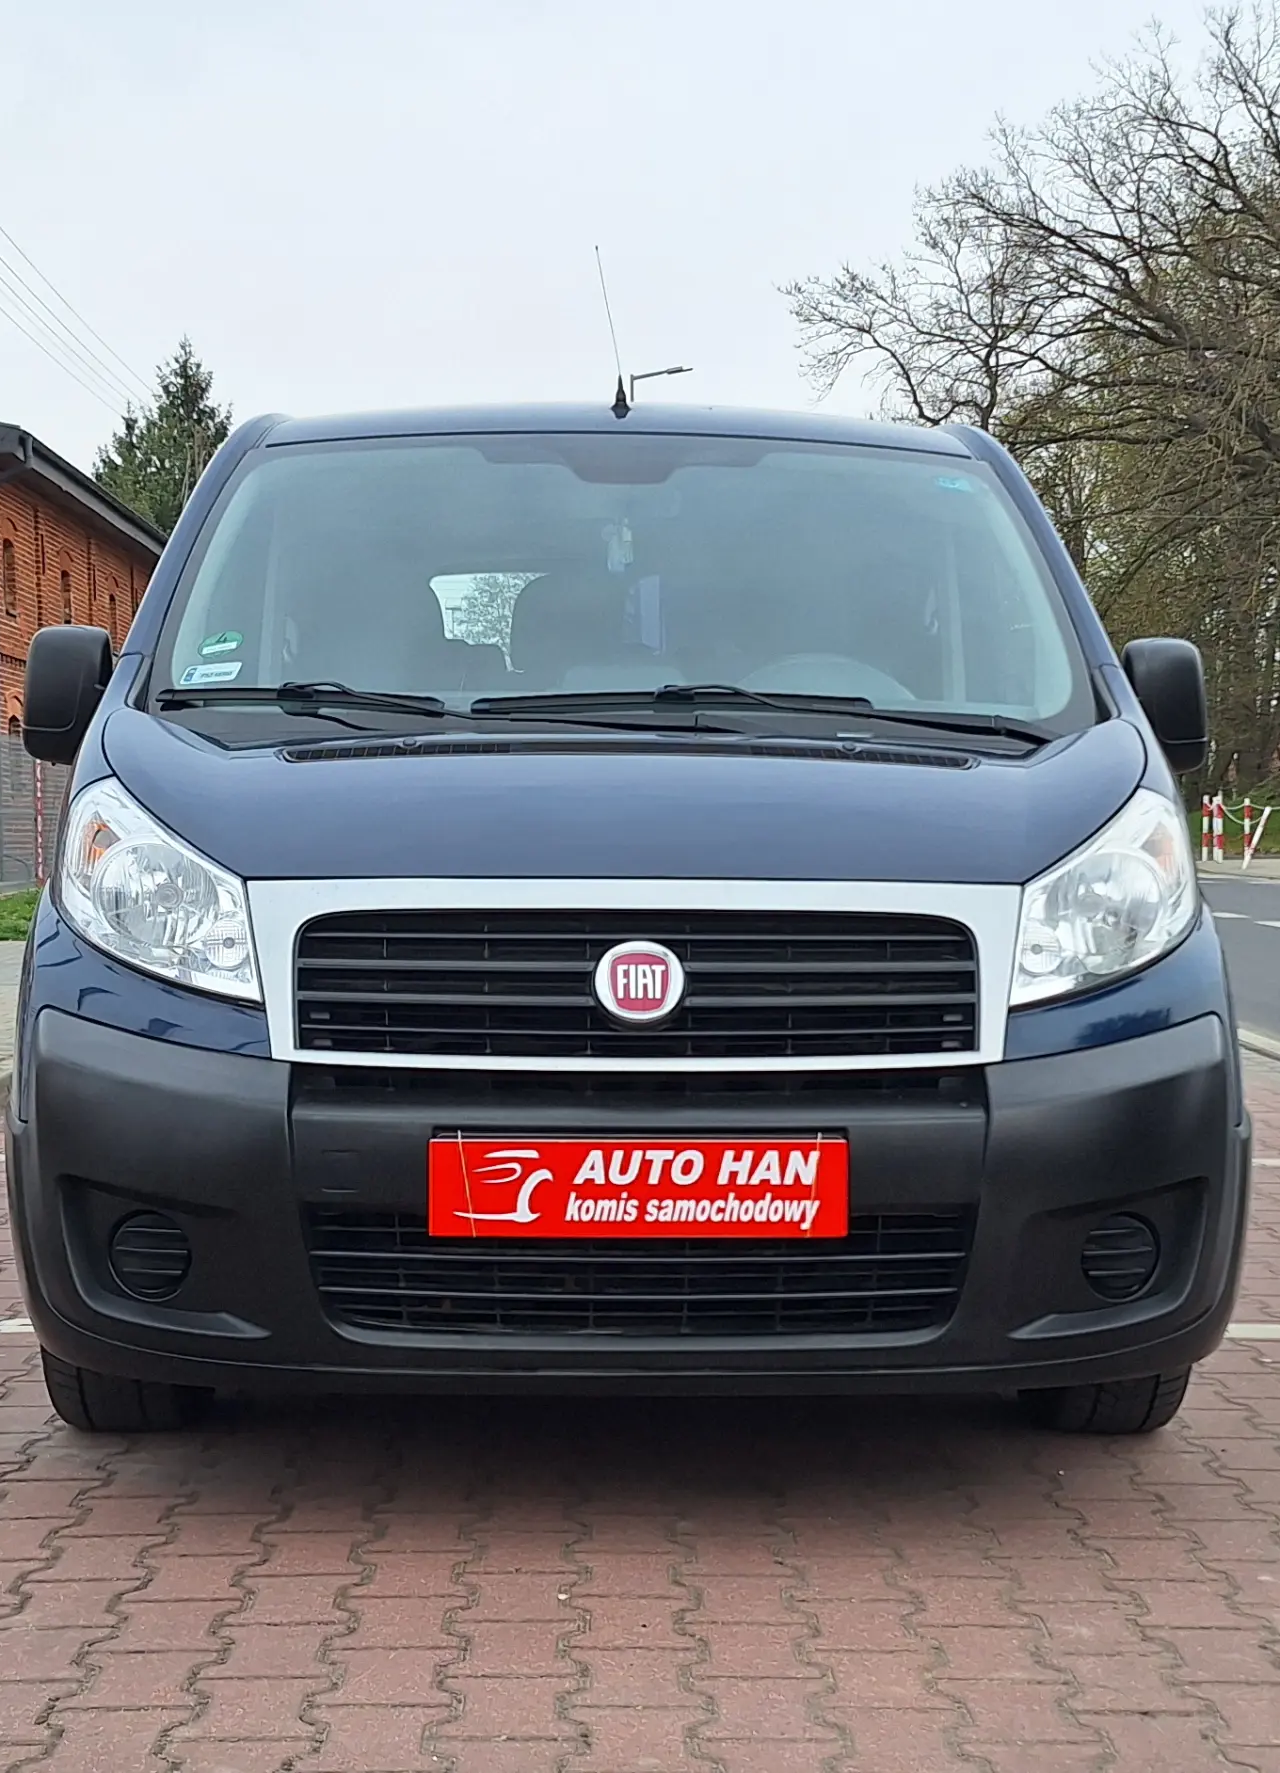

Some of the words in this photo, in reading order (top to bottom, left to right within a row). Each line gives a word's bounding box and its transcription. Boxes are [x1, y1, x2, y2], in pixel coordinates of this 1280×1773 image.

[616, 964, 666, 999] FIAT
[573, 1149, 704, 1186] AUTO
[717, 1149, 821, 1186] HAN
[565, 1192, 638, 1223] komis
[644, 1192, 819, 1231] samochodowy
